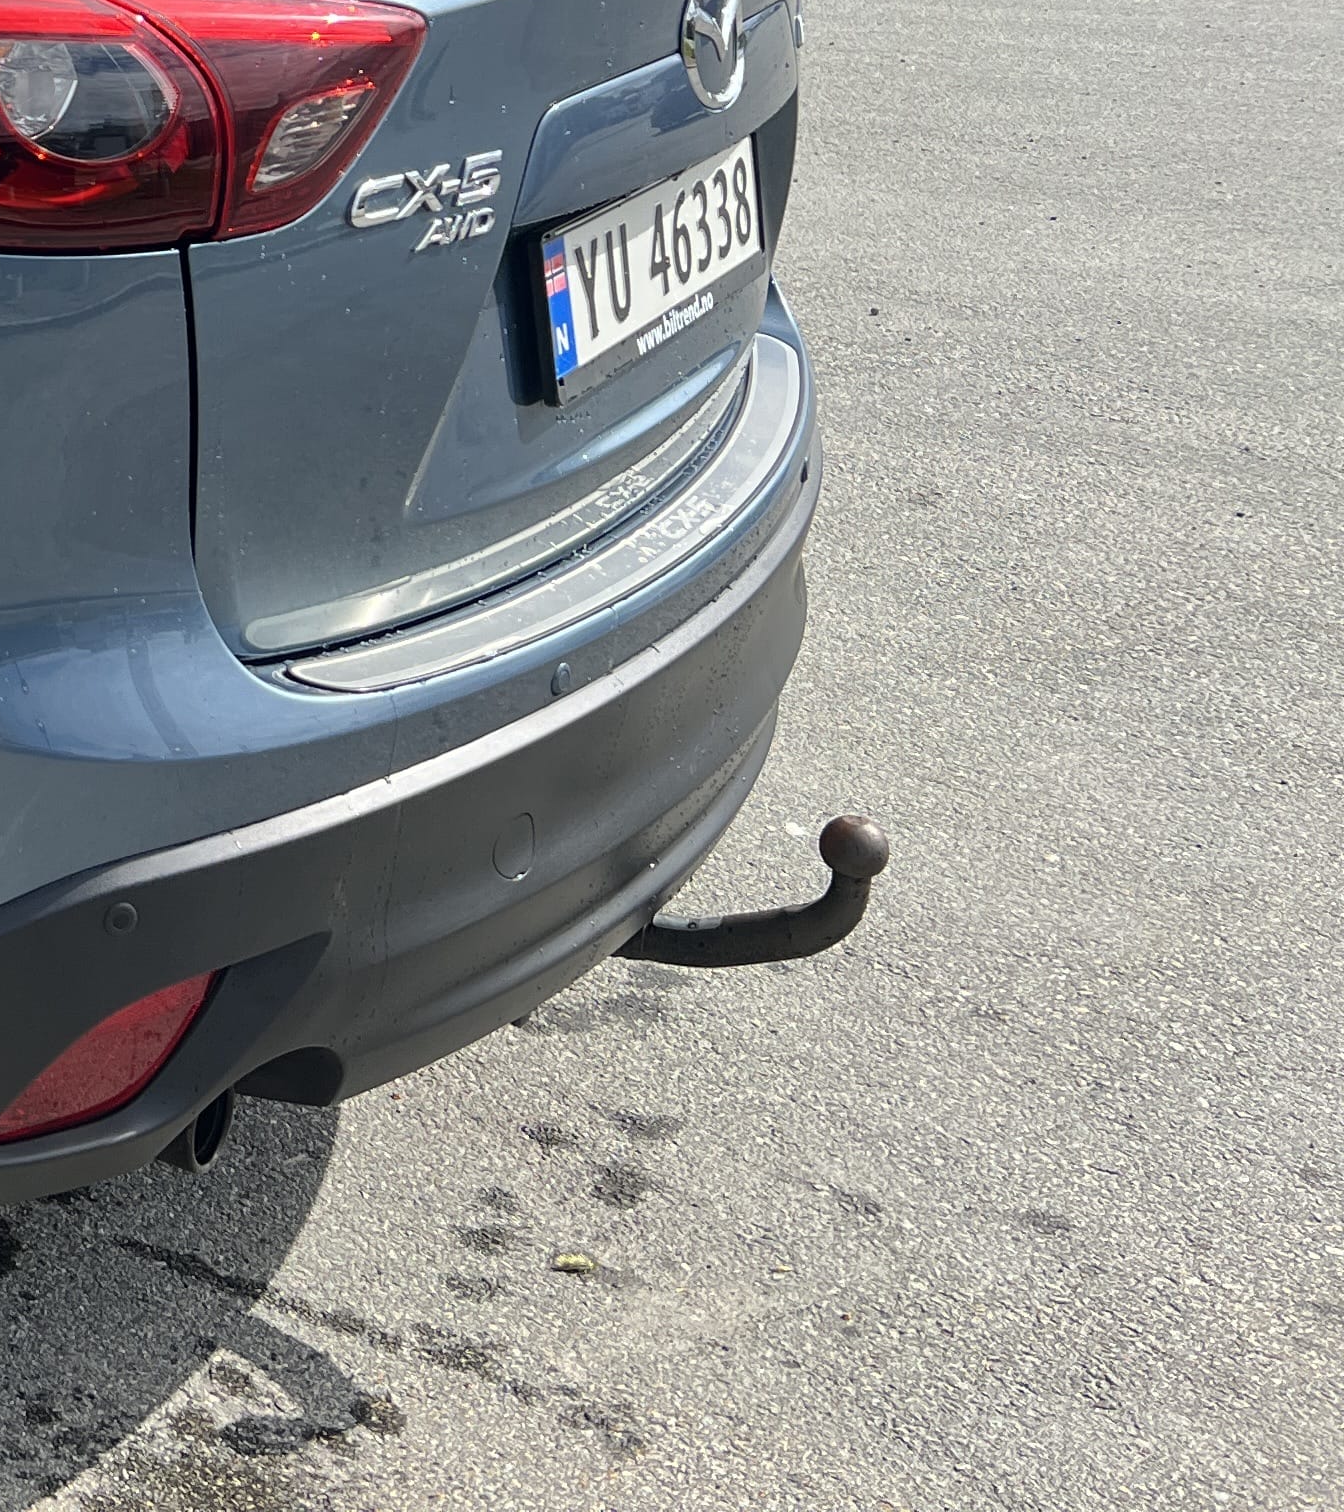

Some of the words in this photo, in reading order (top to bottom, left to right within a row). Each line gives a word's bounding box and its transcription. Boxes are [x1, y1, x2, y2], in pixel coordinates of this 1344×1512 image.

[350, 149, 503, 228] CX-5
[413, 207, 496, 252] AWD
[574, 223, 632, 340] YU
[650, 156, 752, 296] 46338
[555, 323, 571, 355] N
[636, 291, 714, 355] www.biltrend.no
